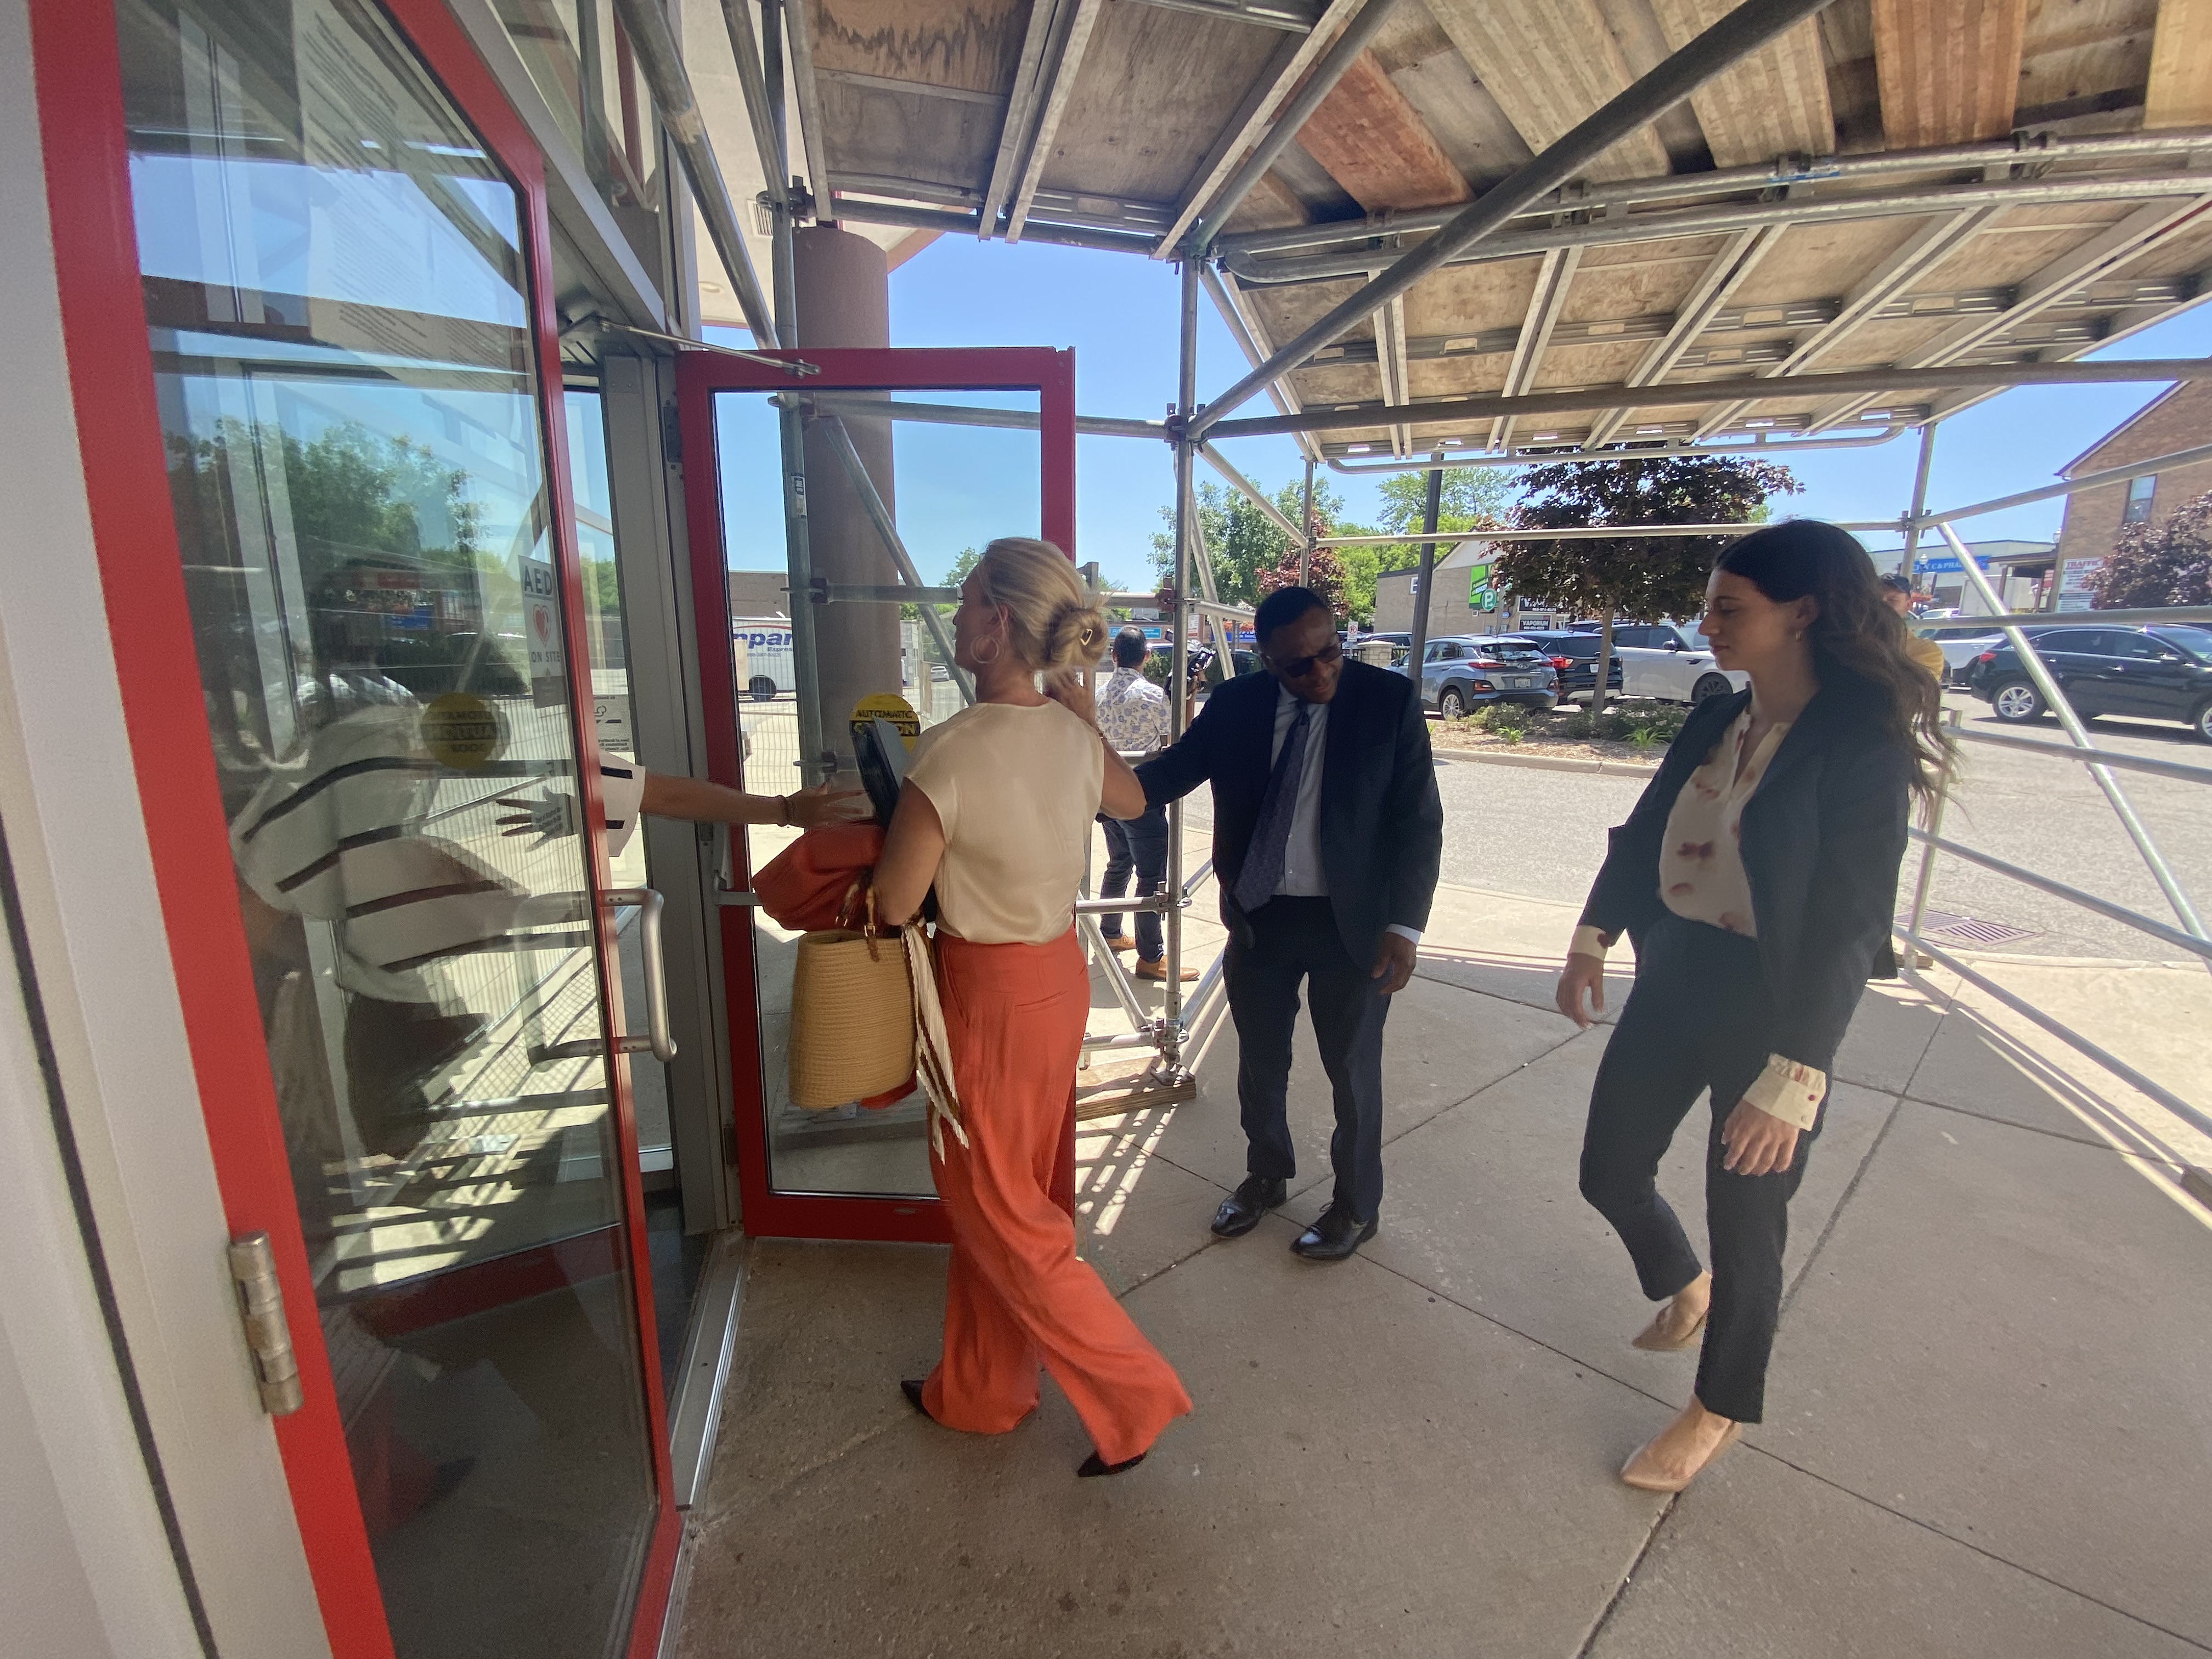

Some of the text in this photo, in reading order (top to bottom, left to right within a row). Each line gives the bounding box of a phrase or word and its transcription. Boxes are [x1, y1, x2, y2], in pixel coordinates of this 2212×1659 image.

[524, 566, 553, 595] AED
[1485, 592, 1493, 608] P
[531, 651, 561, 663] ON SITE
